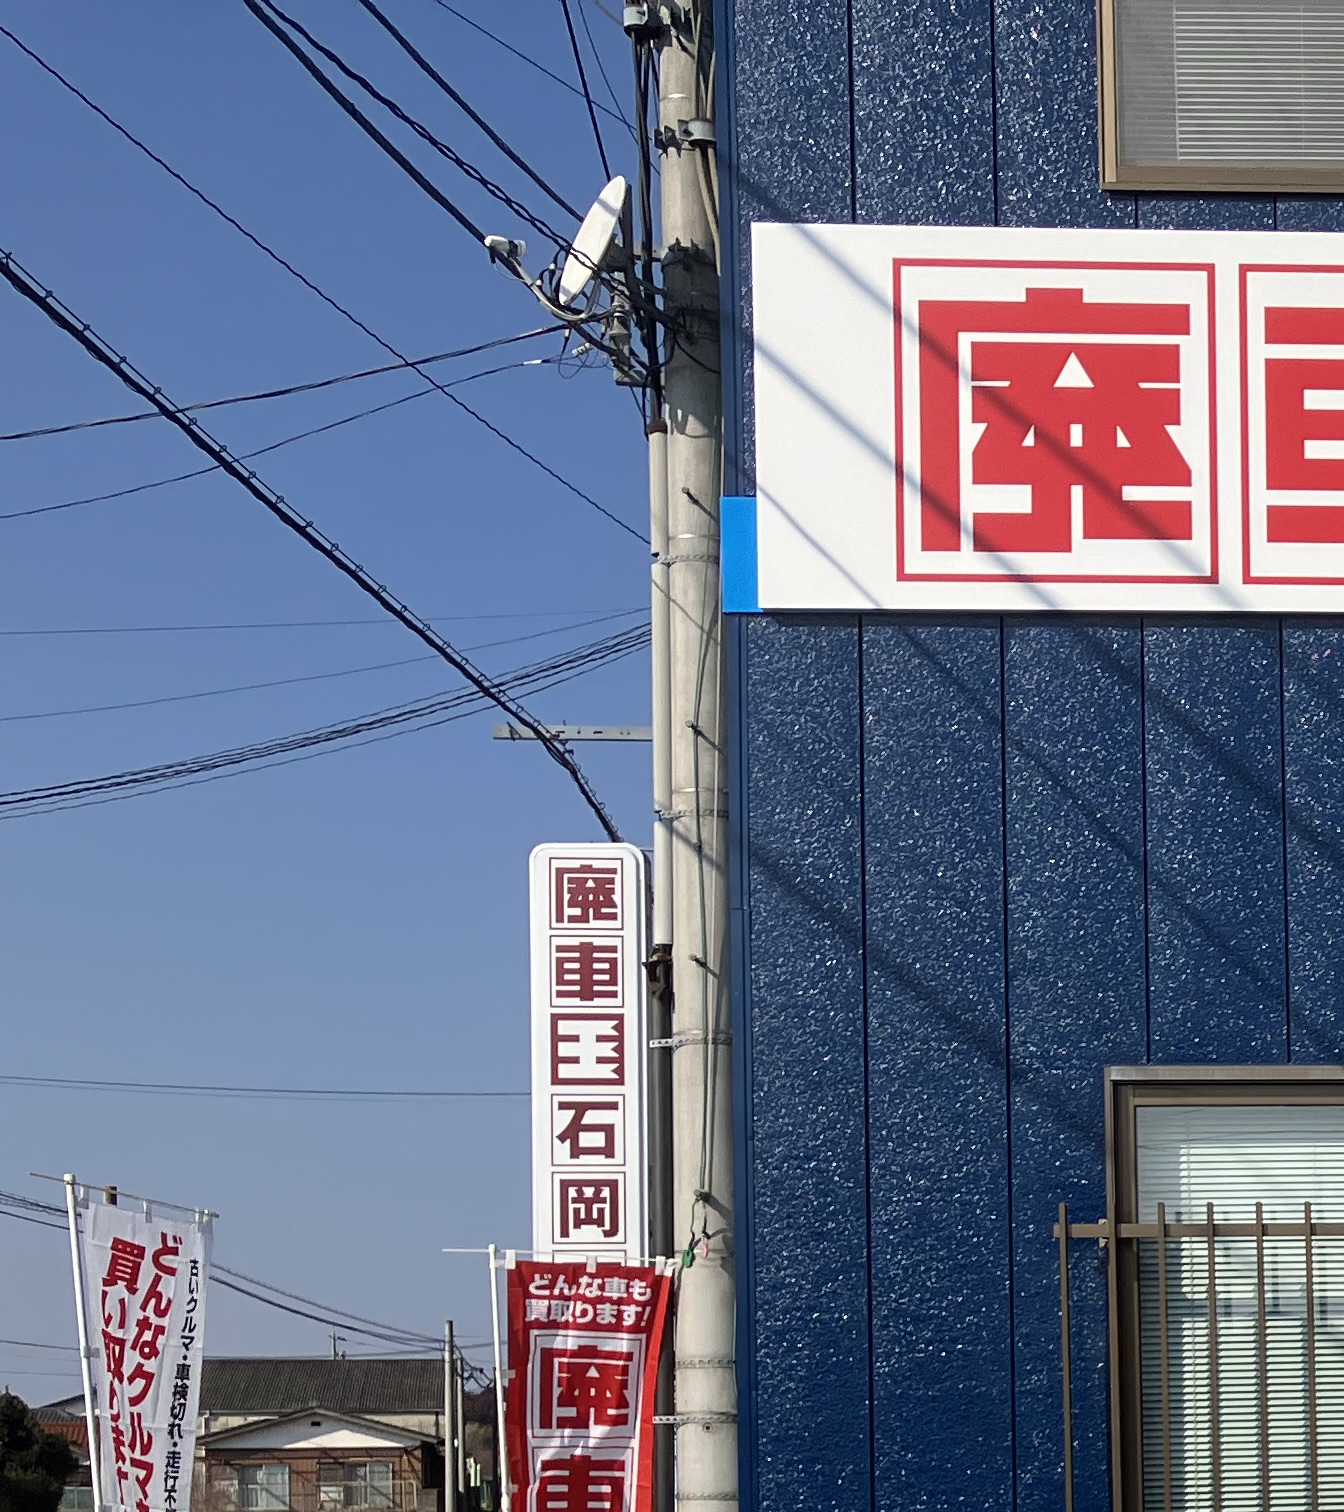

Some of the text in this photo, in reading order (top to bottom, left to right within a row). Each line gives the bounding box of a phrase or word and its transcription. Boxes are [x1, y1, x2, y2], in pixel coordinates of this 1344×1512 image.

[528, 1273, 652, 1301] どんな車も
[524, 1298, 652, 1327] 買取ります!
